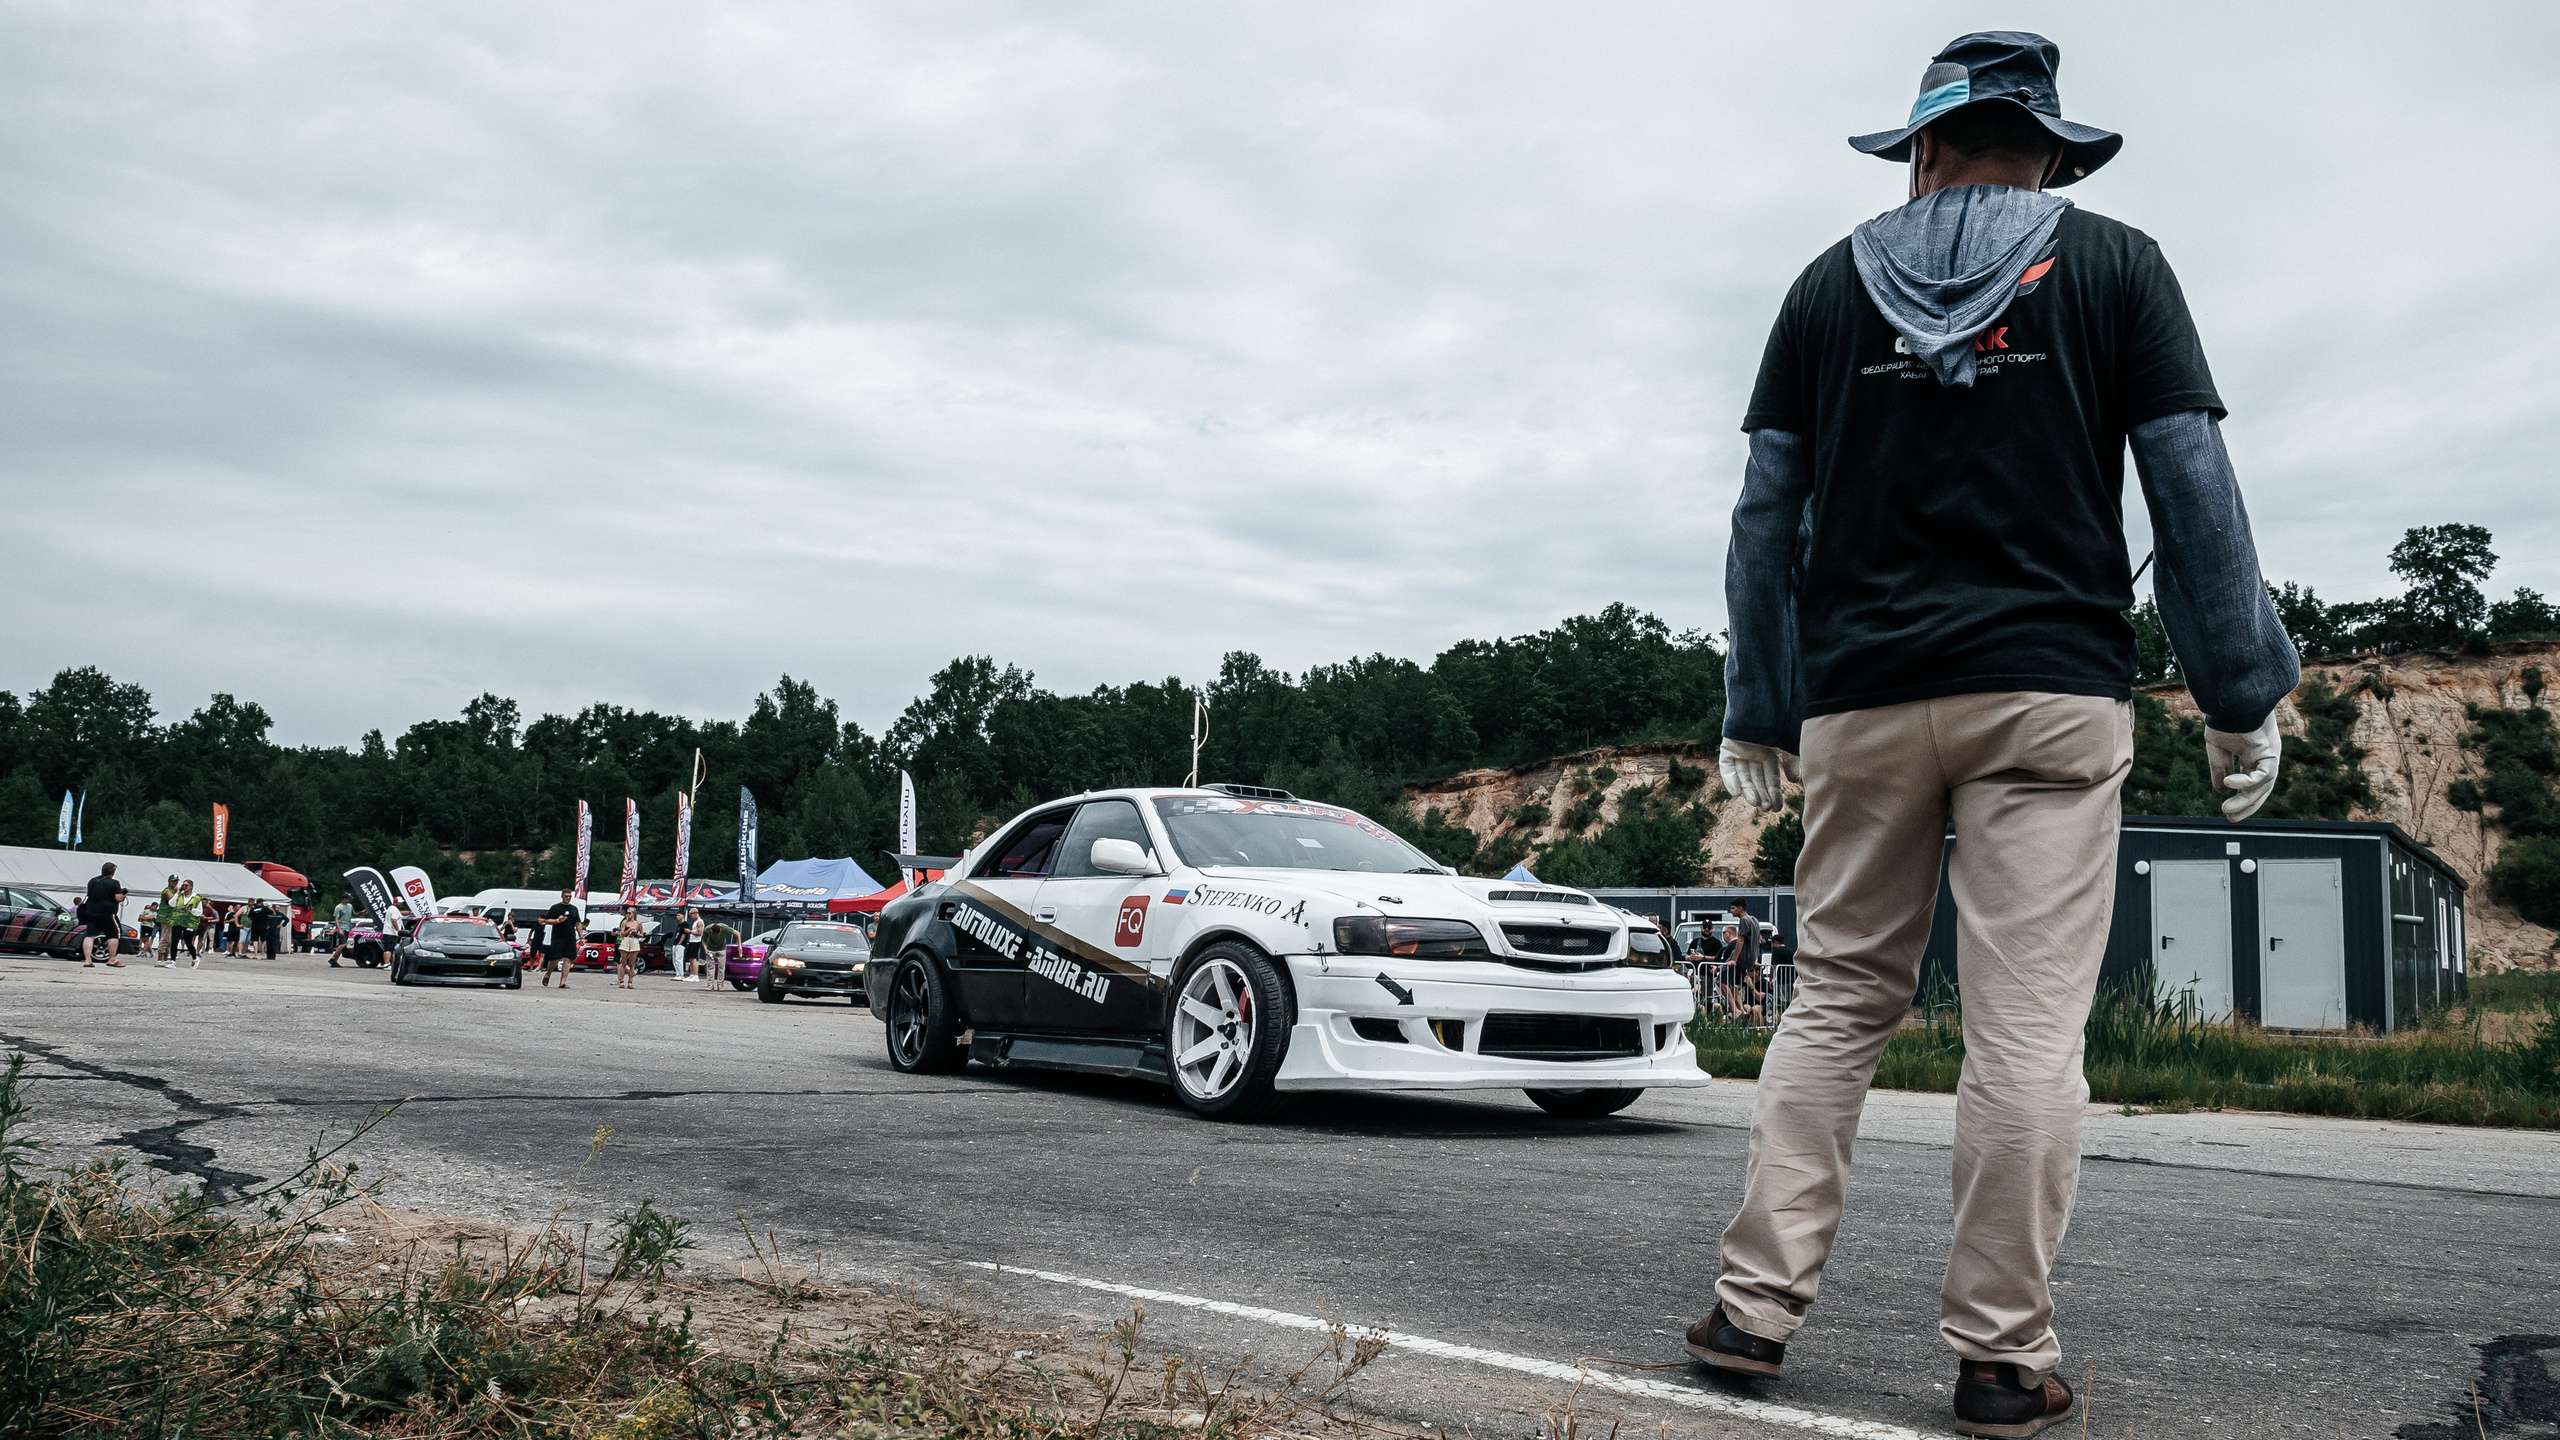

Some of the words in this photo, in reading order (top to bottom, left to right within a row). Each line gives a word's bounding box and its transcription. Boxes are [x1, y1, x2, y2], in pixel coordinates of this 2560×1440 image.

[1861, 361, 1914, 375] ФЕДЕРАЦИЯ
[2007, 353, 2047, 363] СПОРТА
[1117, 906, 1144, 934] FQ
[586, 949, 599, 958] FQ
